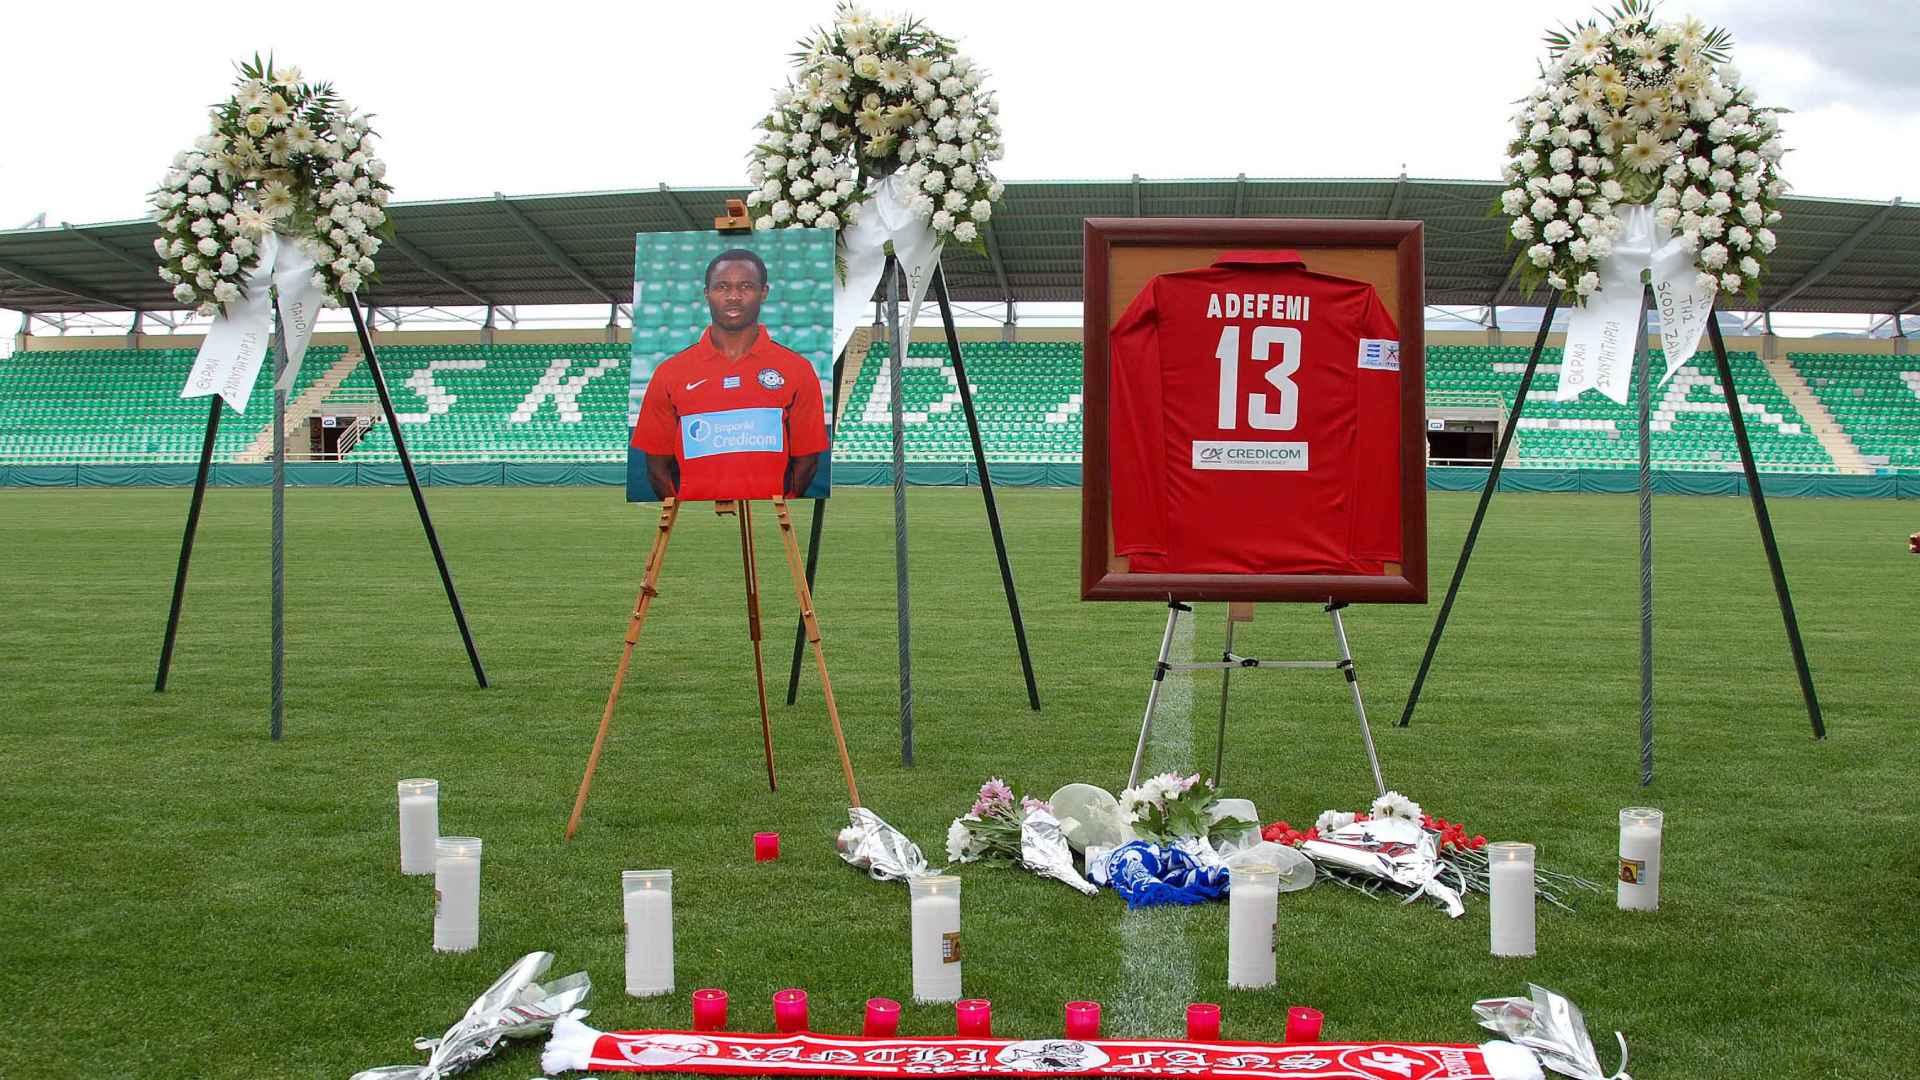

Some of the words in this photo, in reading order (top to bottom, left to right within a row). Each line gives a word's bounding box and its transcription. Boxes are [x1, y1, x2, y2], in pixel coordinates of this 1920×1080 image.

[1206, 293, 1310, 321] ADEFEMI
[1215, 325, 1302, 431] 13
[713, 432, 777, 448] Credicom
[1226, 448, 1301, 460] CREDICOM
[1118, 1050, 1331, 1069] FANS
